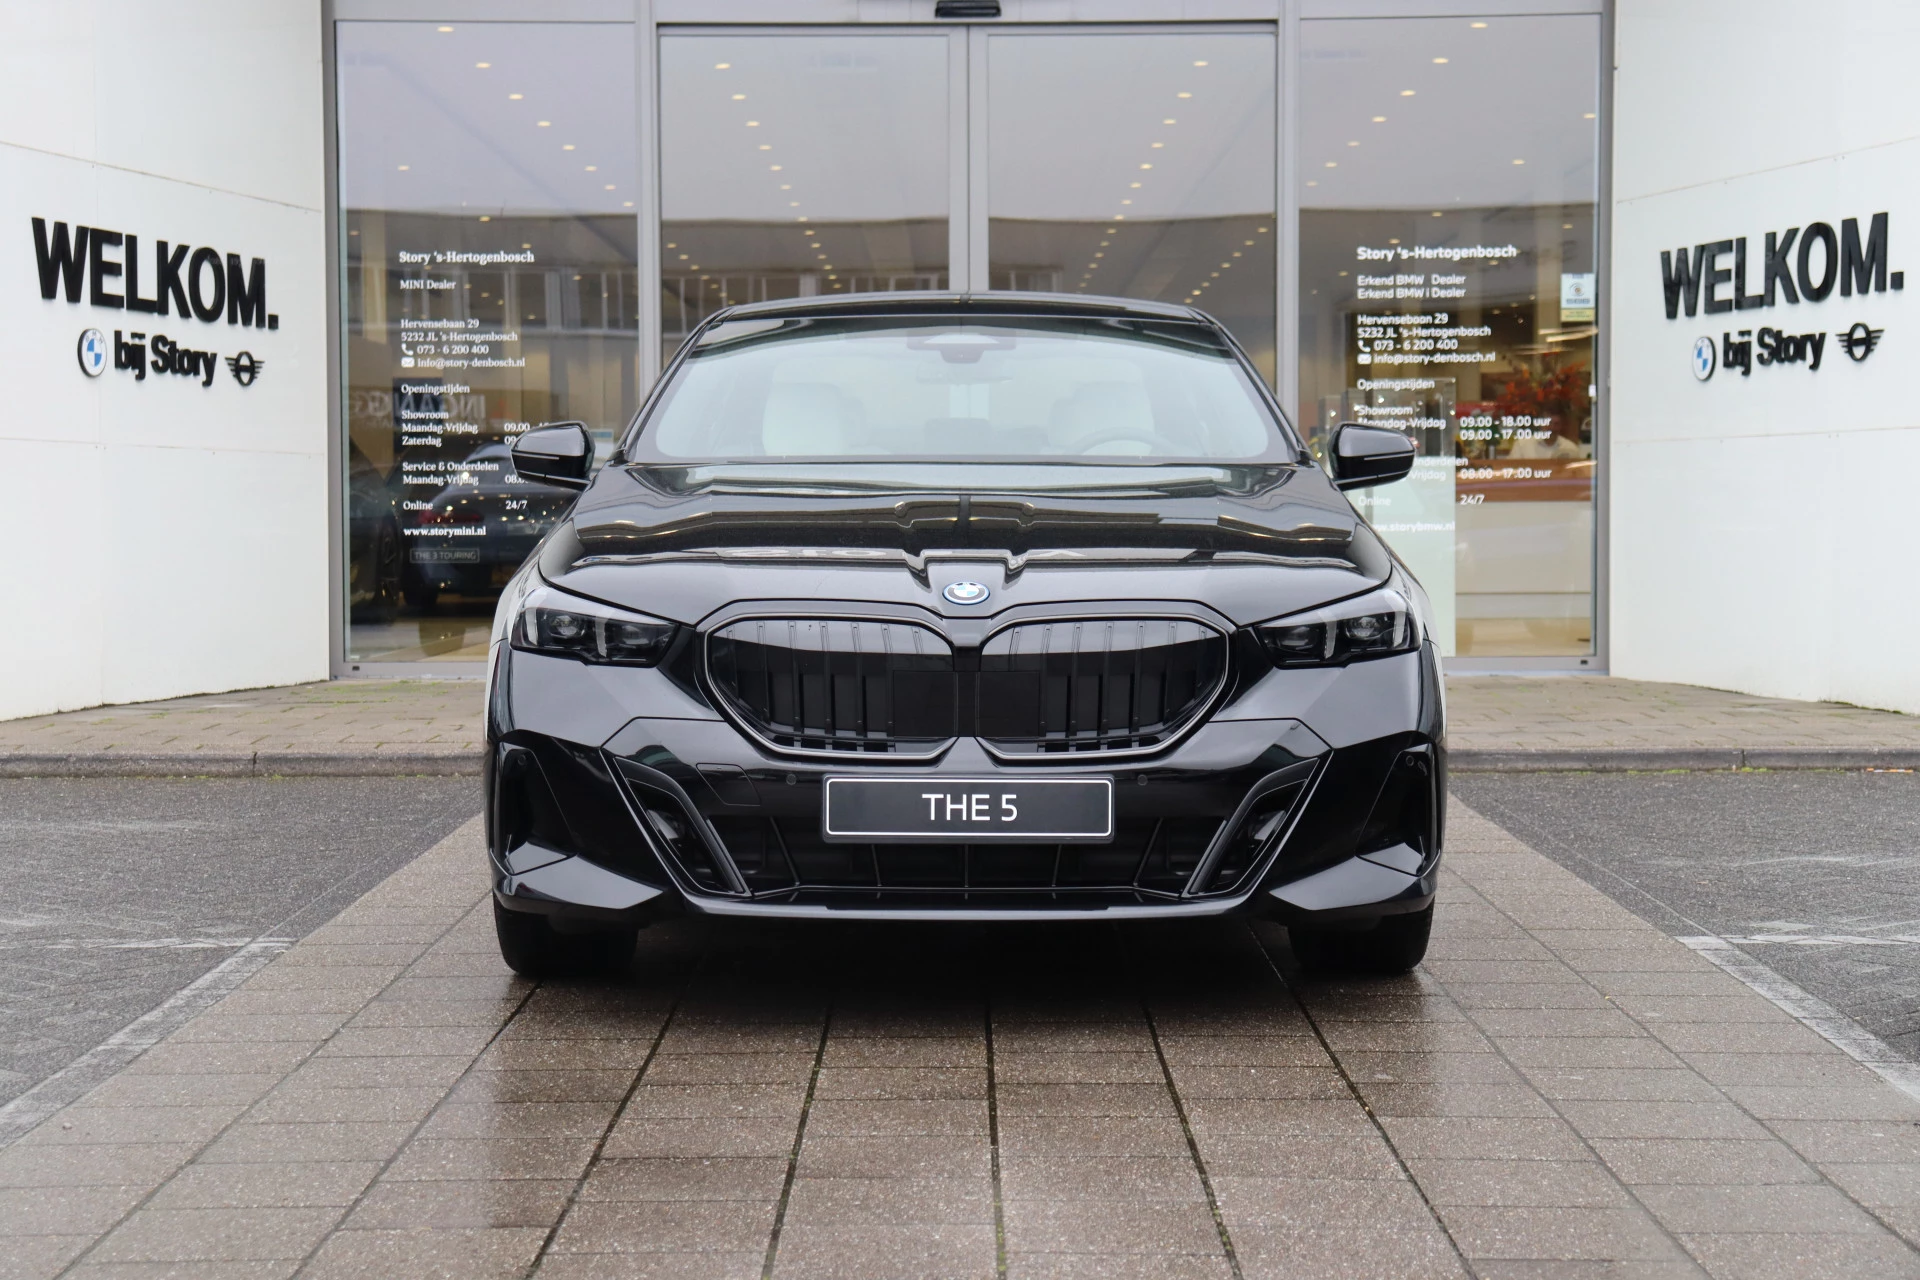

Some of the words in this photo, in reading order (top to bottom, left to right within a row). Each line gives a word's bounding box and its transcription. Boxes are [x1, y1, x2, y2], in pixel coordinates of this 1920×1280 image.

[399, 251, 431, 265] Story
[1357, 246, 1394, 261] Story
[1397, 244, 1517, 260] 's-Hertogenbosch
[1661, 212, 1904, 319] WELKOM.
[32, 217, 279, 329] WELKOM.
[400, 280, 424, 289] MINI
[427, 280, 456, 289] Dealer
[1357, 275, 1394, 286] Erkend
[1396, 275, 1424, 285] BMW
[1431, 274, 1466, 284] Dealer
[1357, 287, 1394, 299] Erkend
[1396, 287, 1424, 298] BMW
[1431, 287, 1466, 298] Dealer
[401, 319, 465, 328] Hervensebaan
[467, 319, 480, 328] 29
[1357, 314, 1432, 325] Hervensebaan
[1434, 312, 1449, 324] 29
[401, 332, 424, 342] 5232
[426, 332, 438, 342] JL
[1357, 327, 1383, 338] 5232
[1386, 327, 1398, 338] JL
[1399, 326, 1492, 338] 's-Hertogenbosch
[417, 345, 435, 354] 073
[443, 345, 450, 354] 6
[452, 345, 469, 354] 200
[471, 345, 489, 354] 400
[1373, 340, 1394, 350] 073
[1403, 340, 1411, 350] 6
[1413, 339, 1434, 350] 200
[1436, 339, 1458, 350] 400
[1723, 330, 1752, 376] bij
[1756, 327, 1826, 371] Story
[114, 330, 146, 381] bij
[151, 335, 217, 386] Story
[418, 358, 526, 370] info@story-denbosch.nl
[1374, 352, 1496, 365] info@story-denbosch.nl
[401, 384, 470, 395] Openingstijden
[1357, 379, 1435, 391] Openingstijden
[402, 410, 449, 420] Showroom
[1358, 405, 1413, 416] Showroom
[1460, 416, 1492, 427] 09.00
[1502, 415, 1531, 427] 18.00
[1533, 417, 1551, 426] uur
[402, 423, 478, 434] Maandag-Vrijdag
[504, 423, 530, 432] 09.00
[1461, 429, 1493, 440] 09.00
[1534, 430, 1552, 439] uur
[402, 435, 442, 447] Zaterdag
[403, 462, 437, 471] Service
[438, 463, 445, 471] &
[447, 462, 499, 471] Onderdelen
[1414, 458, 1468, 467] nderdelen
[1460, 468, 1493, 479] 08.00
[1534, 469, 1552, 478] uur
[403, 475, 479, 486] Maandag-Vrijdag
[403, 501, 433, 511] Online
[505, 501, 527, 510] 24/7
[1359, 496, 1392, 506] Online
[1460, 494, 1485, 505] 24/7
[403, 526, 487, 538] www.storymini.nl
[414, 551, 430, 560] THE
[432, 551, 438, 560] 3
[440, 551, 477, 560] TOURING
[922, 794, 990, 821] THE
[1001, 794, 1018, 822] 5
